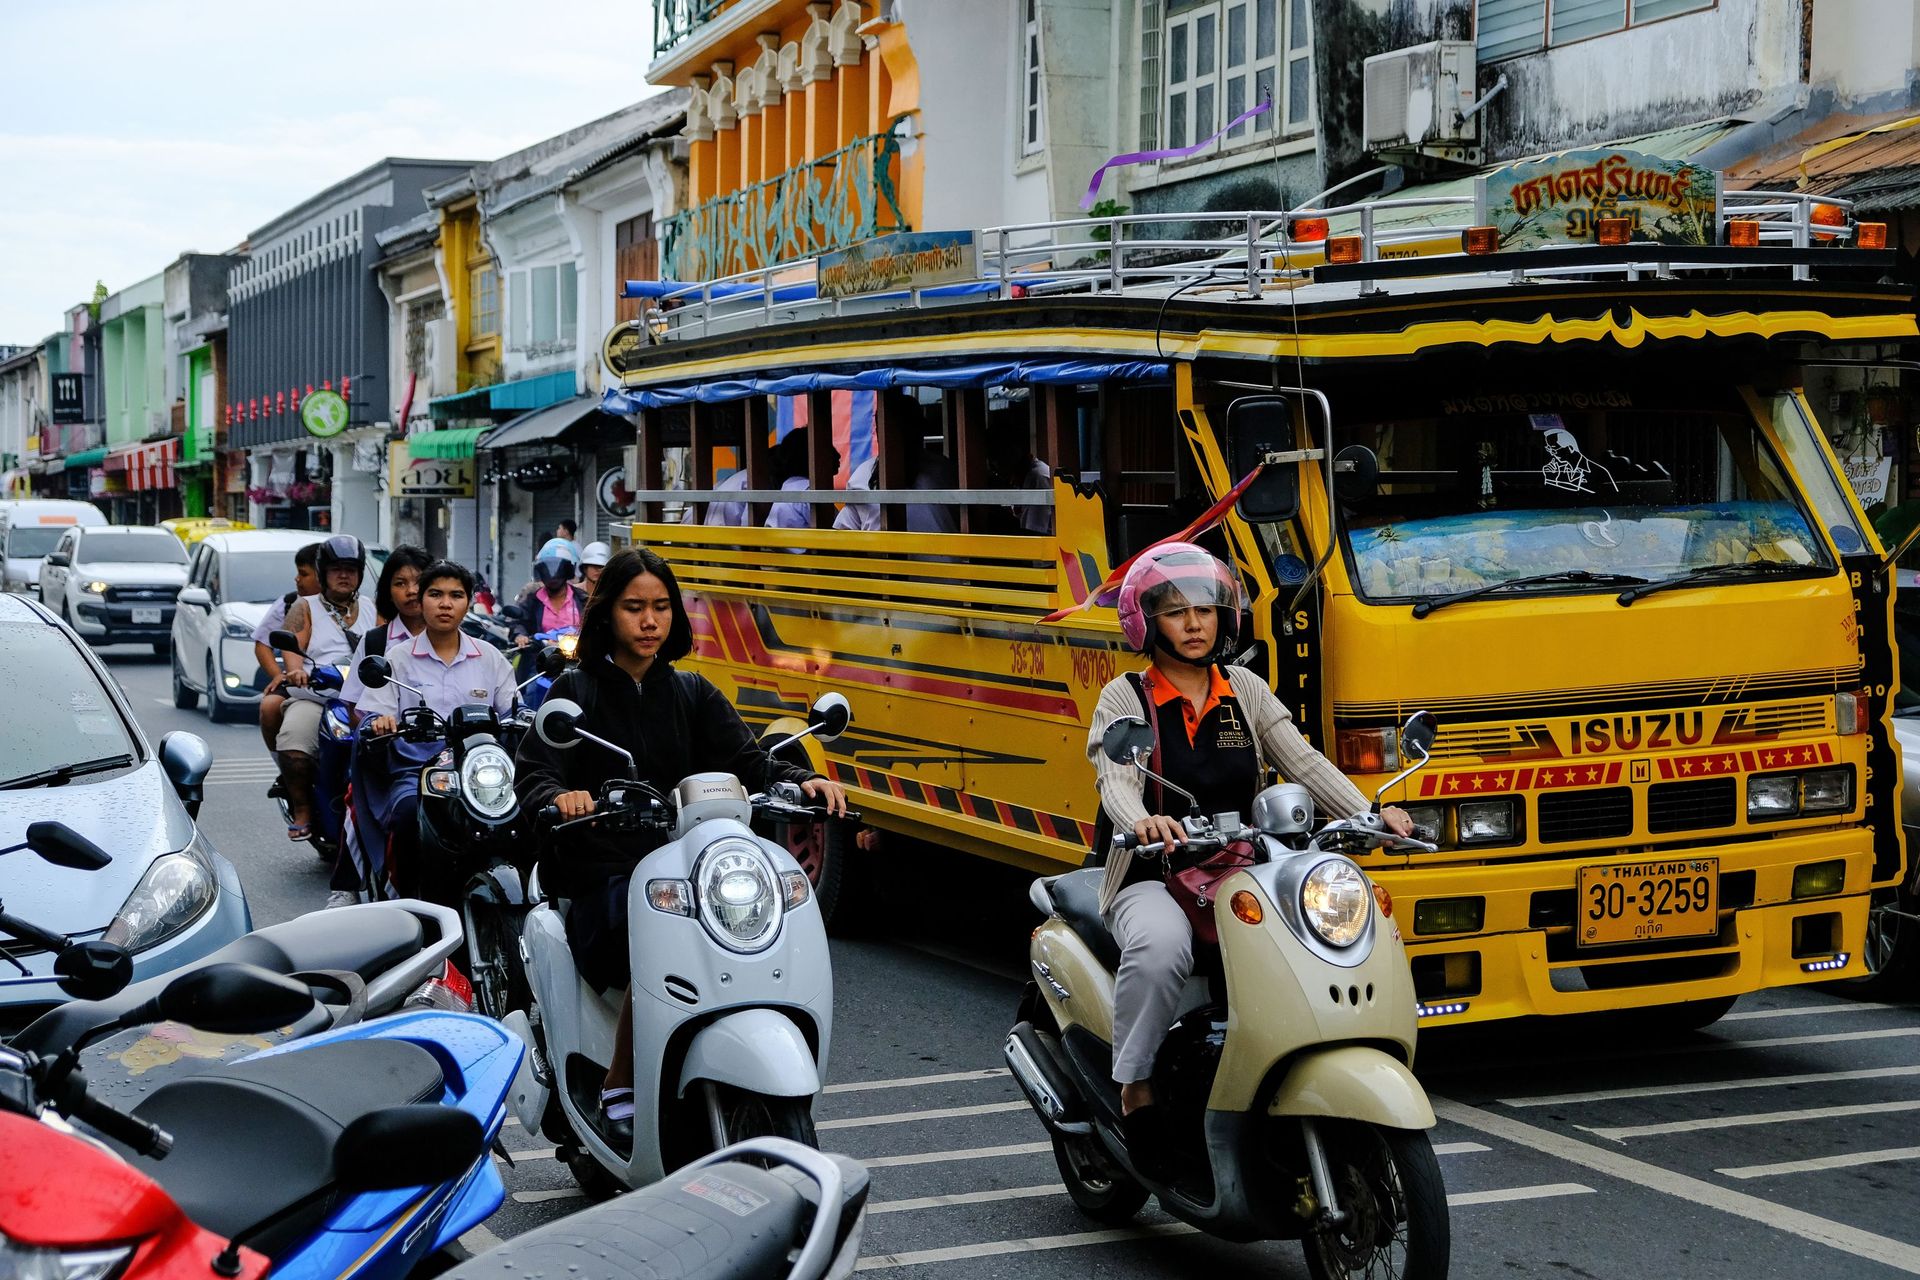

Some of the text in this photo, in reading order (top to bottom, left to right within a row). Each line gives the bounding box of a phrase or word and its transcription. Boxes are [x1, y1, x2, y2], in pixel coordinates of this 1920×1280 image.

[1510, 154, 1694, 216] หาดสุรินทร์
[1570, 711, 1703, 755] ISUZU
[1613, 863, 1686, 879] THAILAND
[1588, 876, 1710, 921] 30-3259
[1634, 920, 1663, 938] ภูเก็ต
